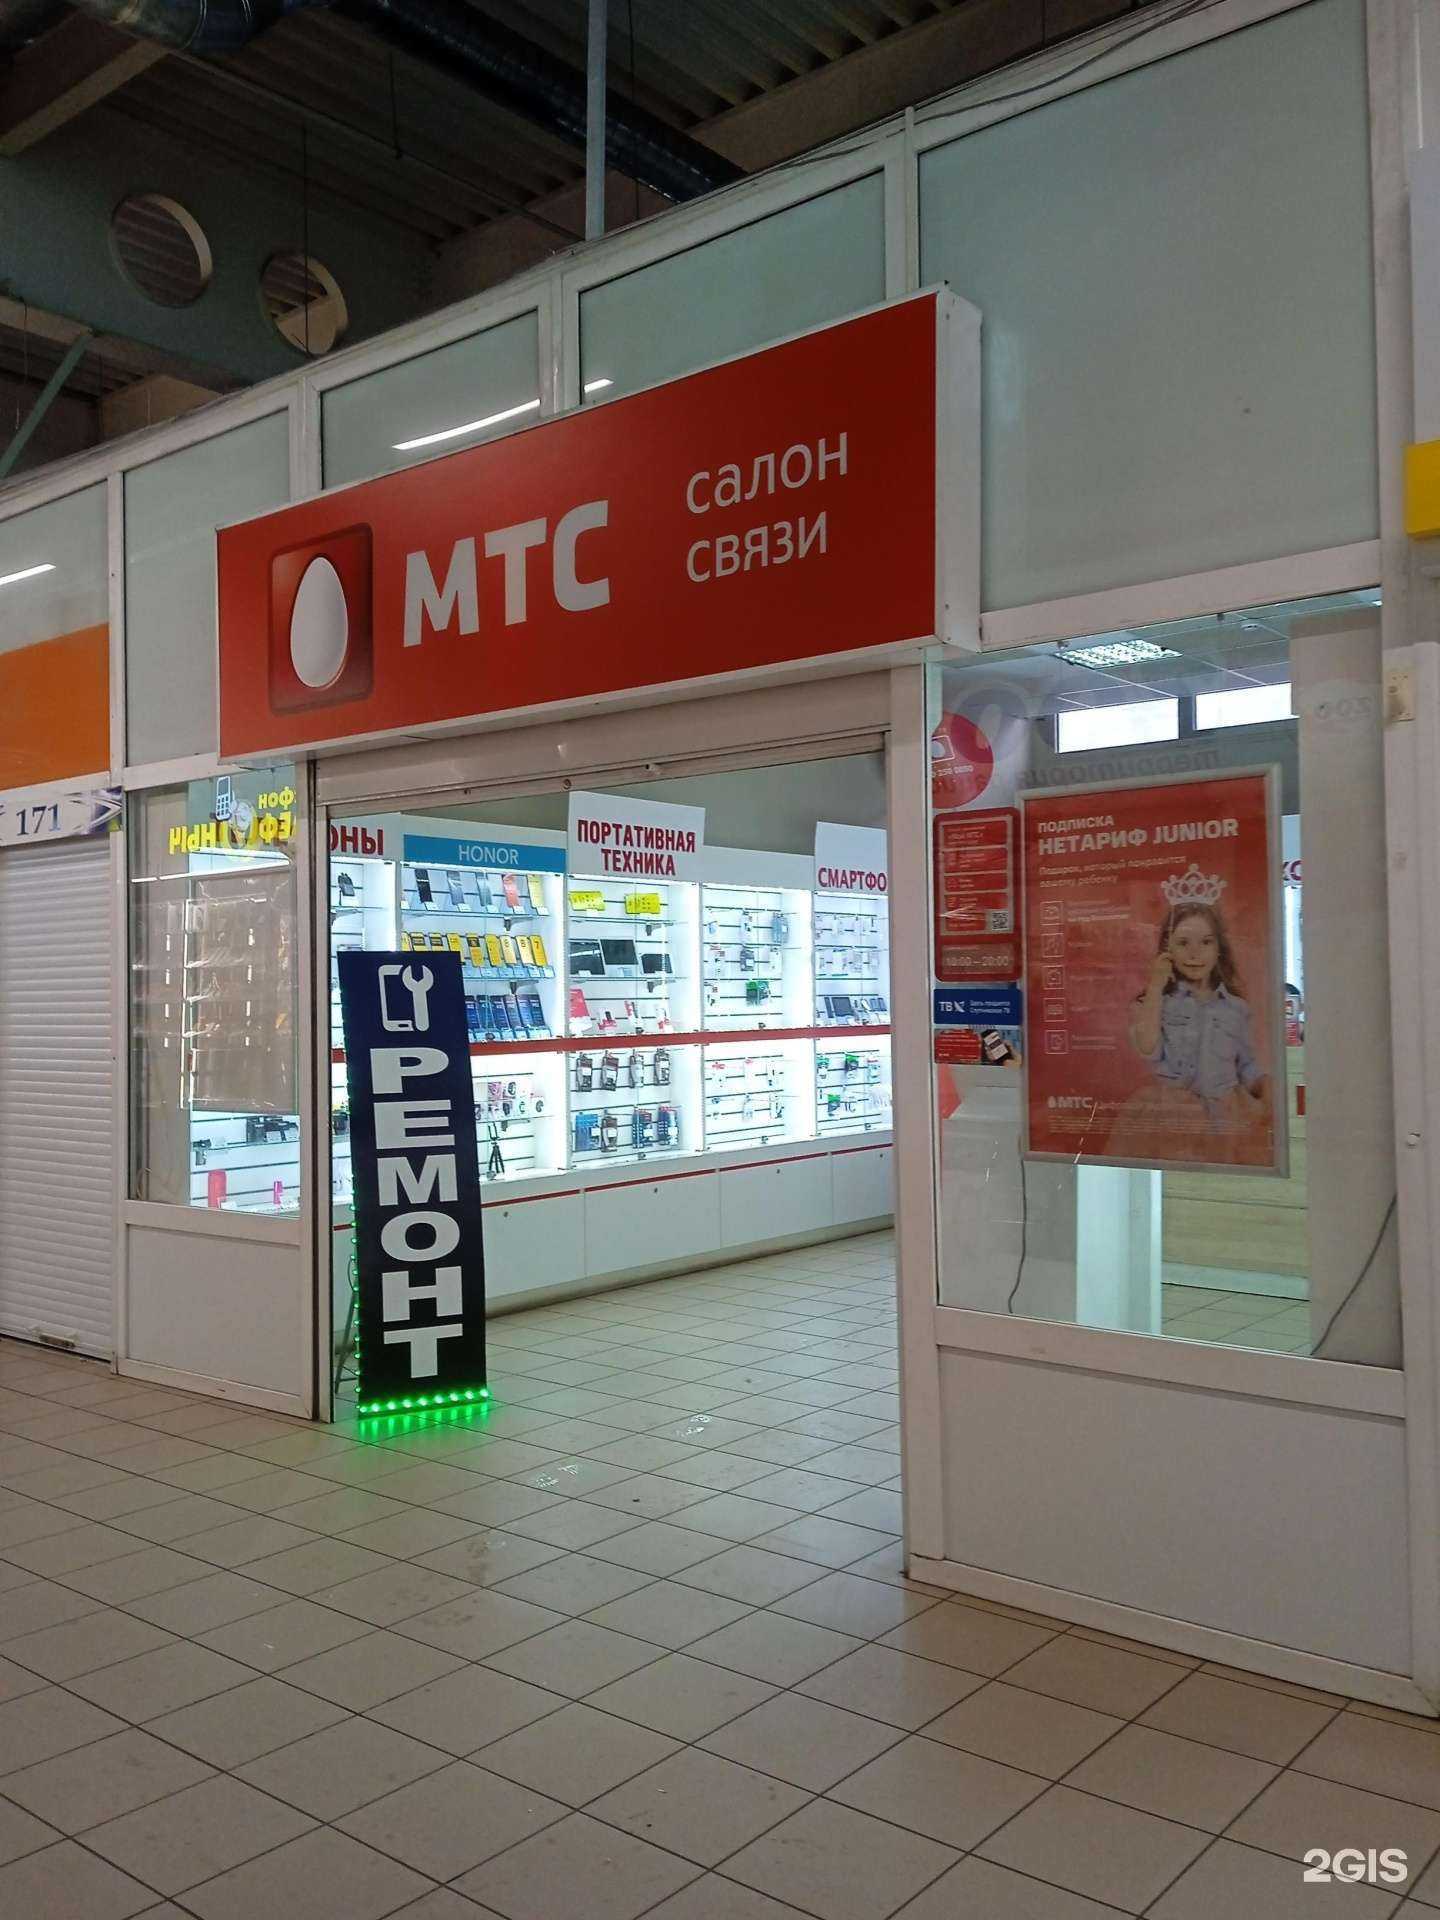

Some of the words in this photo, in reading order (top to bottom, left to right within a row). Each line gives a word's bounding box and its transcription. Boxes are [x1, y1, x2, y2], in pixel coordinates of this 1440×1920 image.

[686, 432, 848, 514] салон
[686, 511, 827, 583] связи
[403, 500, 610, 648] МТС
[16, 804, 60, 836] 171
[577, 819, 696, 852] ПОРТАТИВНАЯ
[1038, 815, 1114, 833] ПОДПИСКА
[1039, 828, 1148, 855] НЕТАРИФ
[1153, 818, 1239, 844] JUNIOR
[458, 844, 519, 865] HONOR
[600, 848, 676, 876] ТЕХНИКА
[818, 867, 887, 891] СМАРТФО
[1057, 1097, 1092, 1109] МТС
[370, 1047, 464, 1379] РЕМОНТ
